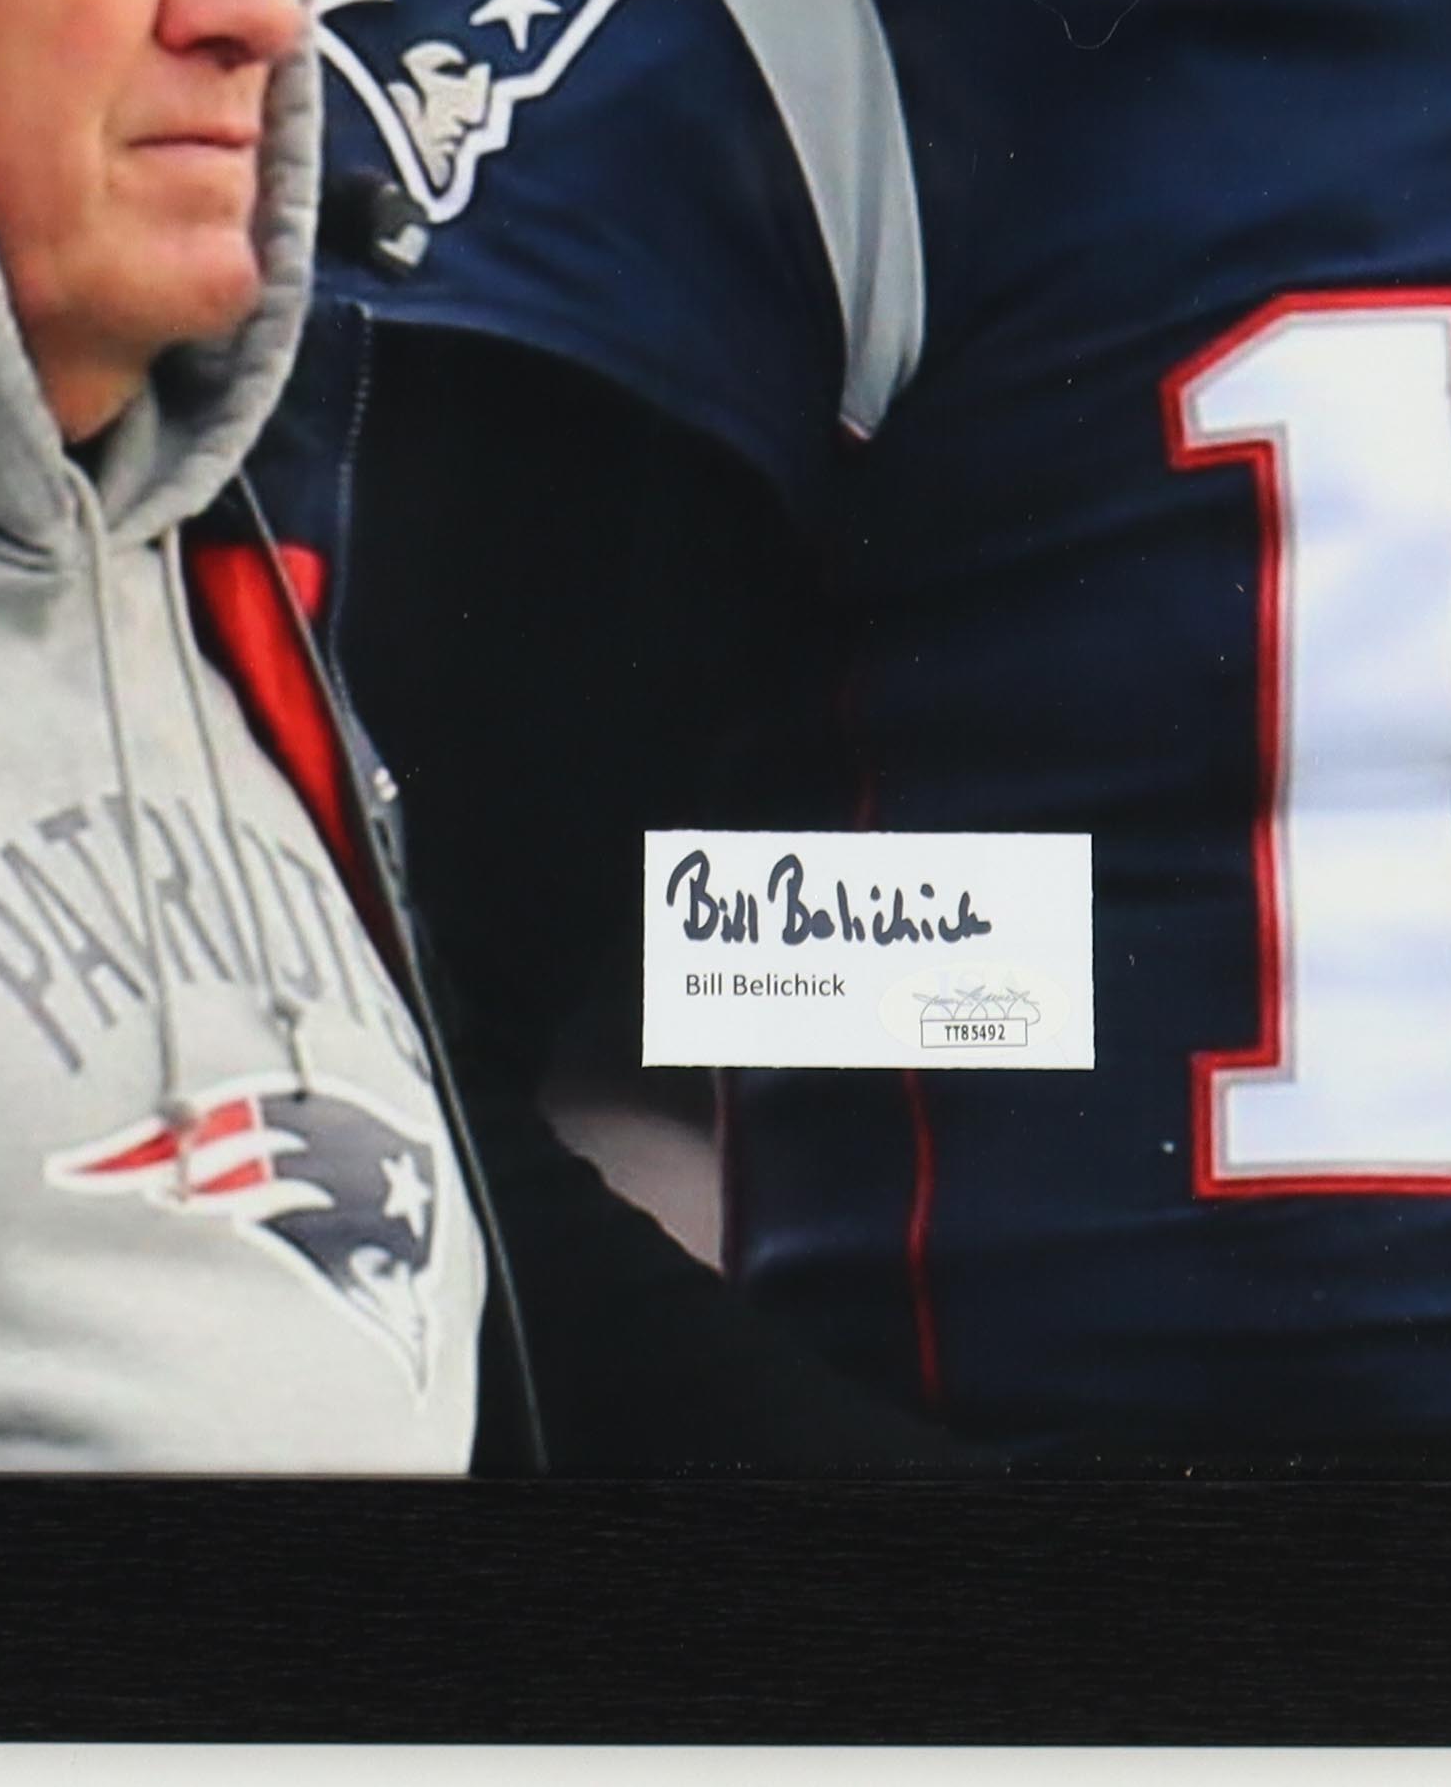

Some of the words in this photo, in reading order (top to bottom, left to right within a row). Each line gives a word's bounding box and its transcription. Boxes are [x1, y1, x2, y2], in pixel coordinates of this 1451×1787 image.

[665, 849, 759, 943] Bill
[685, 972, 722, 997] Bill
[732, 972, 846, 997] Belichick
[944, 1024, 1006, 1042] TT85492
